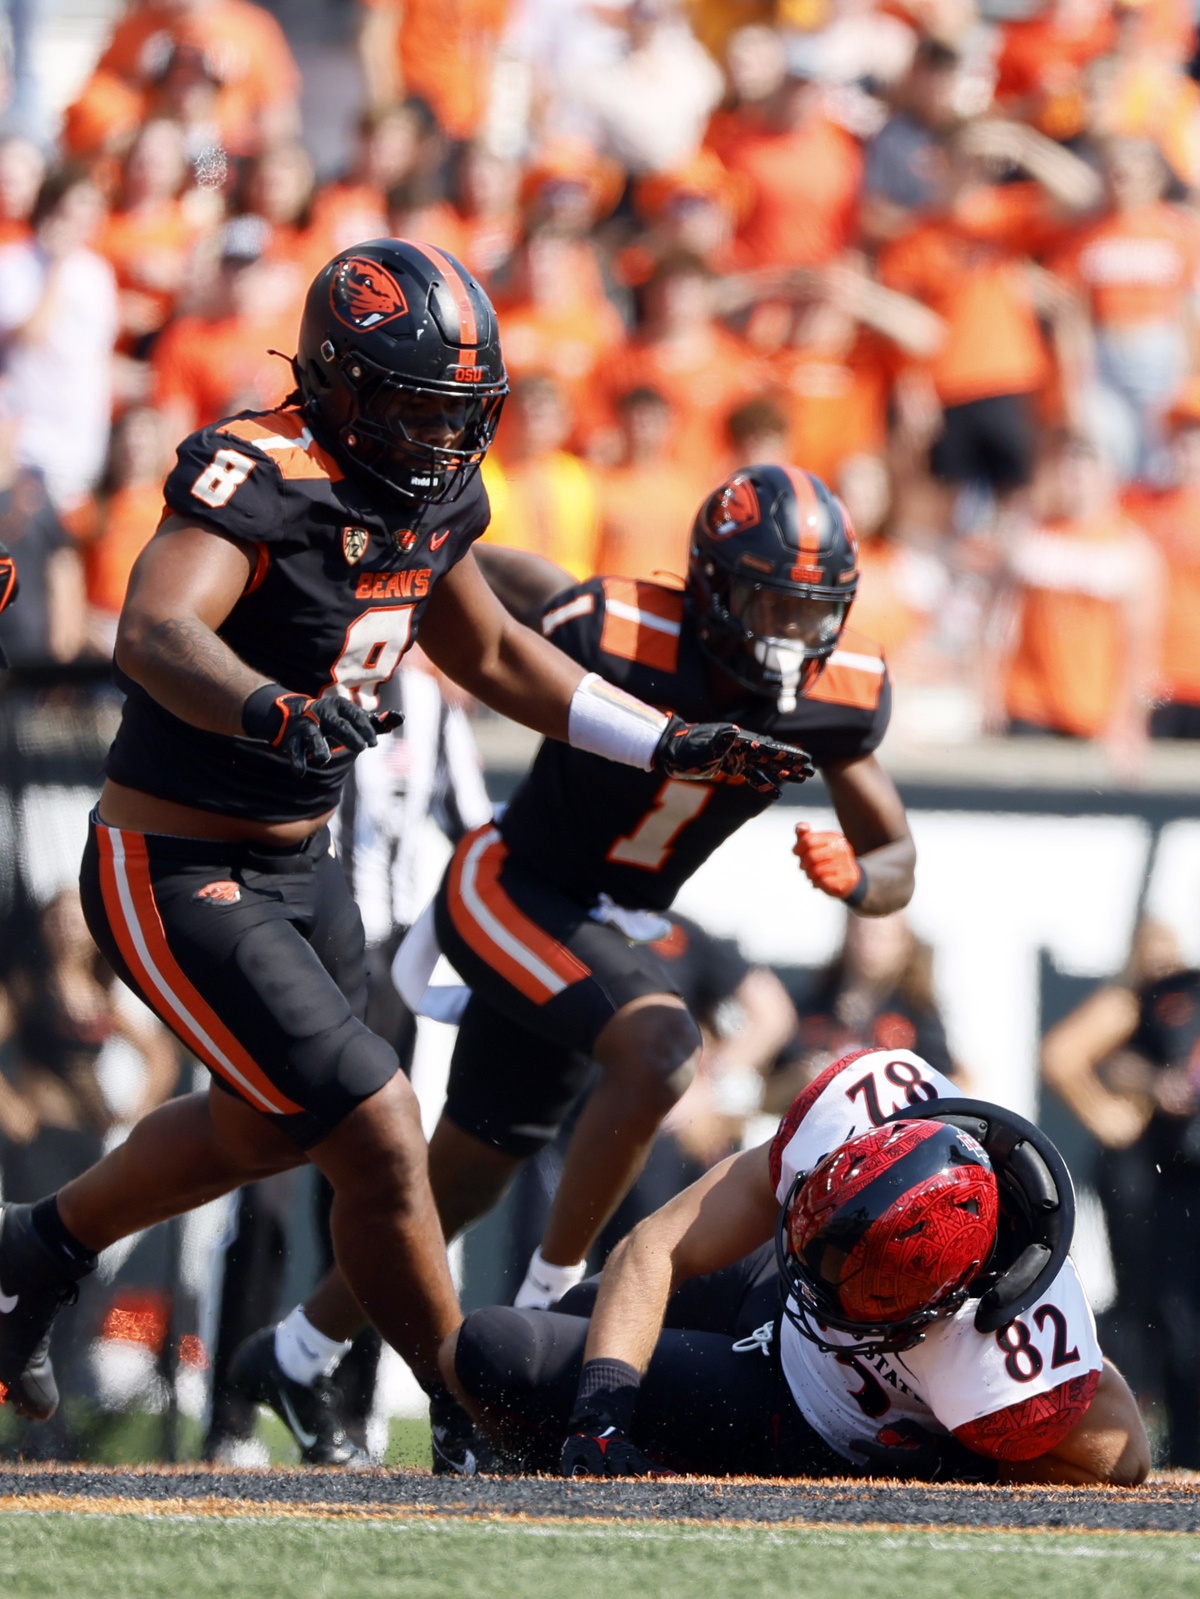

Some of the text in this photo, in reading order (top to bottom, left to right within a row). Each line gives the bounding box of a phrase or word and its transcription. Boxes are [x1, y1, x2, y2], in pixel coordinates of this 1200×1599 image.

[454, 368, 483, 383] OSU
[190, 449, 257, 509] 8
[355, 568, 433, 600] BEAVS
[317, 602, 418, 712] 8
[605, 777, 717, 873] 1
[846, 1060, 938, 1129] 82
[996, 1303, 1081, 1384] 82
